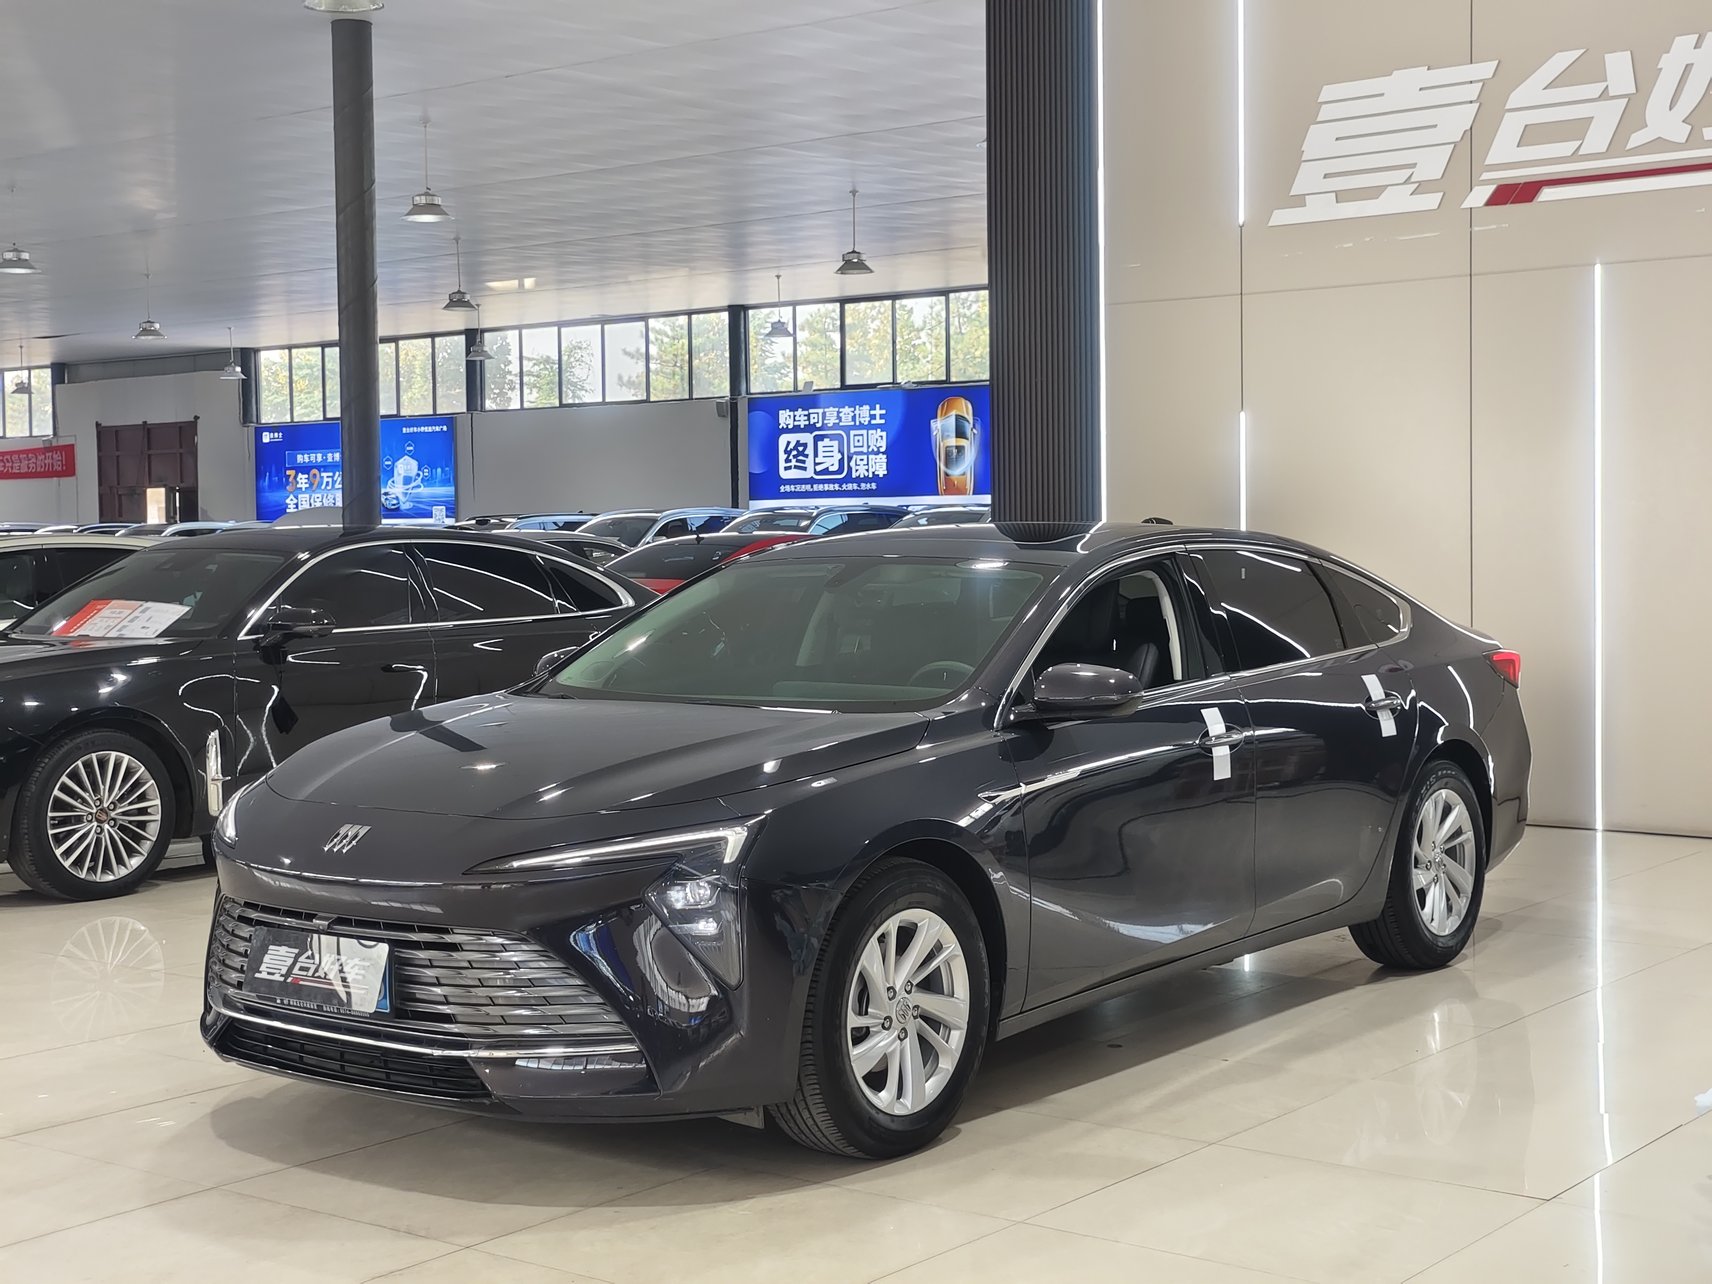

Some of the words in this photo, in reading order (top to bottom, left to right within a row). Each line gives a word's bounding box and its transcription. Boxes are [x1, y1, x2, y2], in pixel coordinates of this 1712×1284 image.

[778, 404, 886, 429] 购车可享查博士
[849, 429, 887, 454] 回购
[782, 437, 843, 473] 终身
[849, 453, 888, 478] 保障
